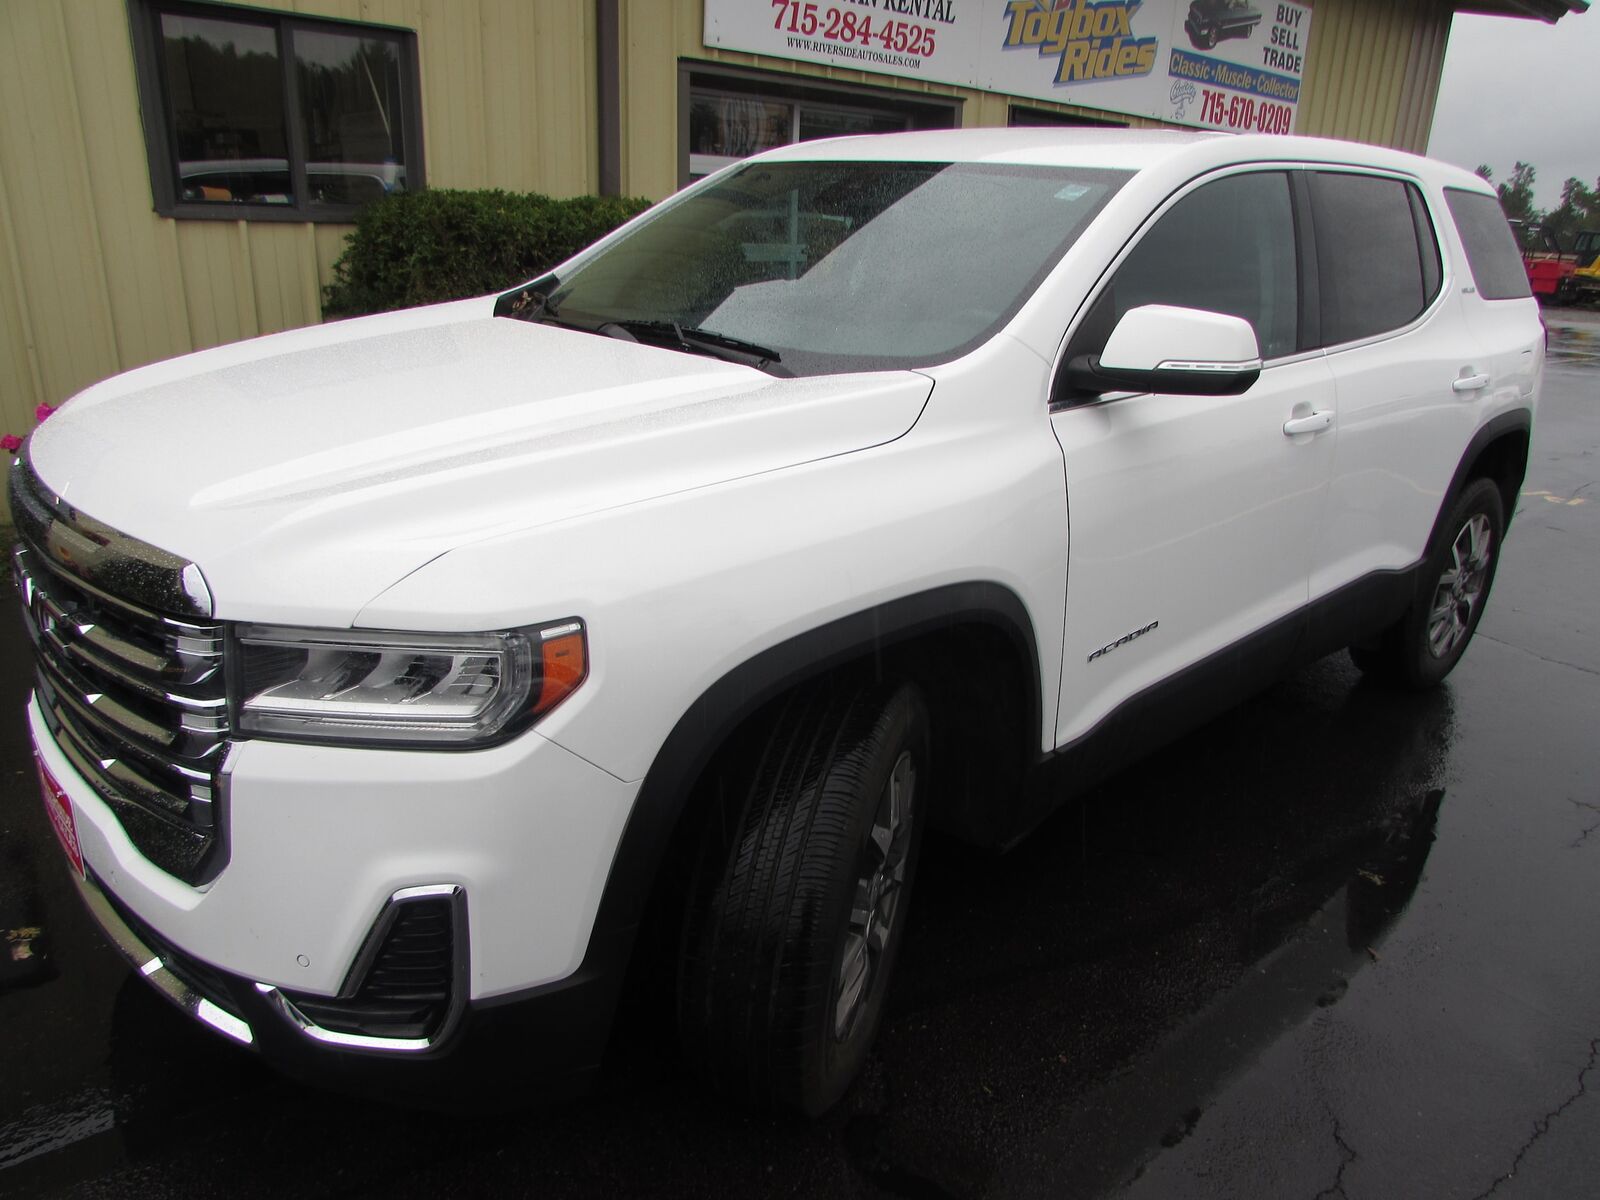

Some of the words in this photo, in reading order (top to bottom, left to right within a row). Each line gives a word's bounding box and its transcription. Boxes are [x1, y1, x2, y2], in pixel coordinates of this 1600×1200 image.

[771, 0, 936, 57] 715-284-4525
[883, 0, 956, 24] RENTAL
[1004, 0, 1141, 55] Toybox
[1276, 4, 1302, 28] BUY
[787, 37, 921, 69] WWW.RIVERSIDEAUTOSALES.COM
[1270, 25, 1299, 50] SELL
[1054, 37, 1158, 84] Rides
[1170, 54, 1210, 79] Classic
[1214, 64, 1252, 89] Muscle
[1256, 74, 1299, 98] Collector
[1263, 47, 1302, 73] TRADE
[1200, 89, 1292, 136] 715-670-0209
[1086, 620, 1159, 663] ACADIA
